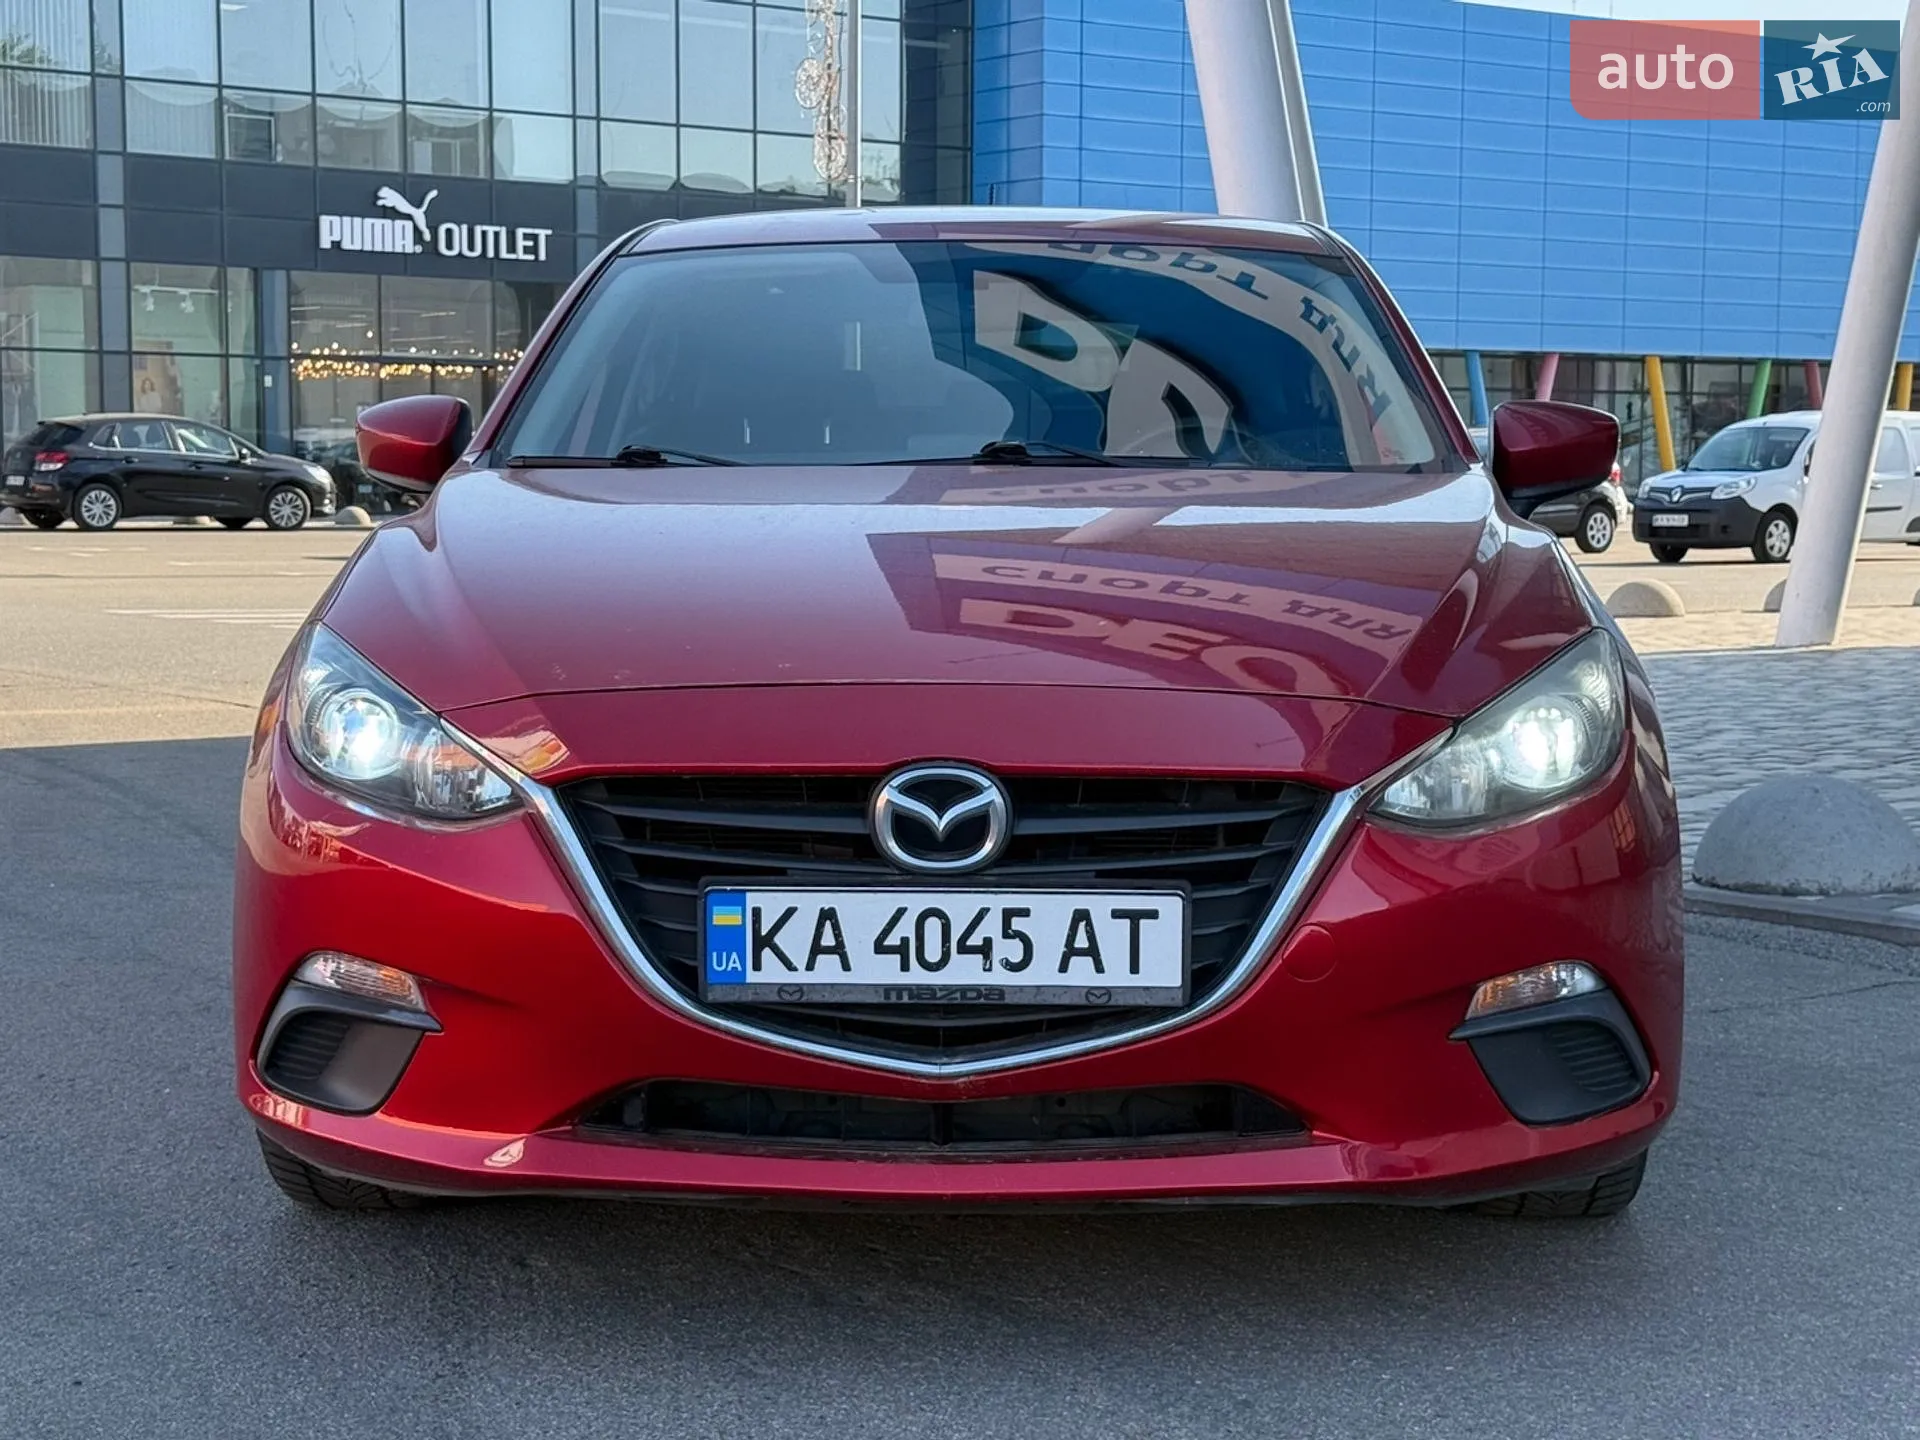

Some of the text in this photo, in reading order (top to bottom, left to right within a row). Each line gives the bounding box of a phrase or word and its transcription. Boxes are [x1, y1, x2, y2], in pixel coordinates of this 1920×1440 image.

[319, 214, 553, 261] PUMA OUTLET
[712, 951, 742, 972] UA
[752, 906, 1160, 975] KA 4045 AT
